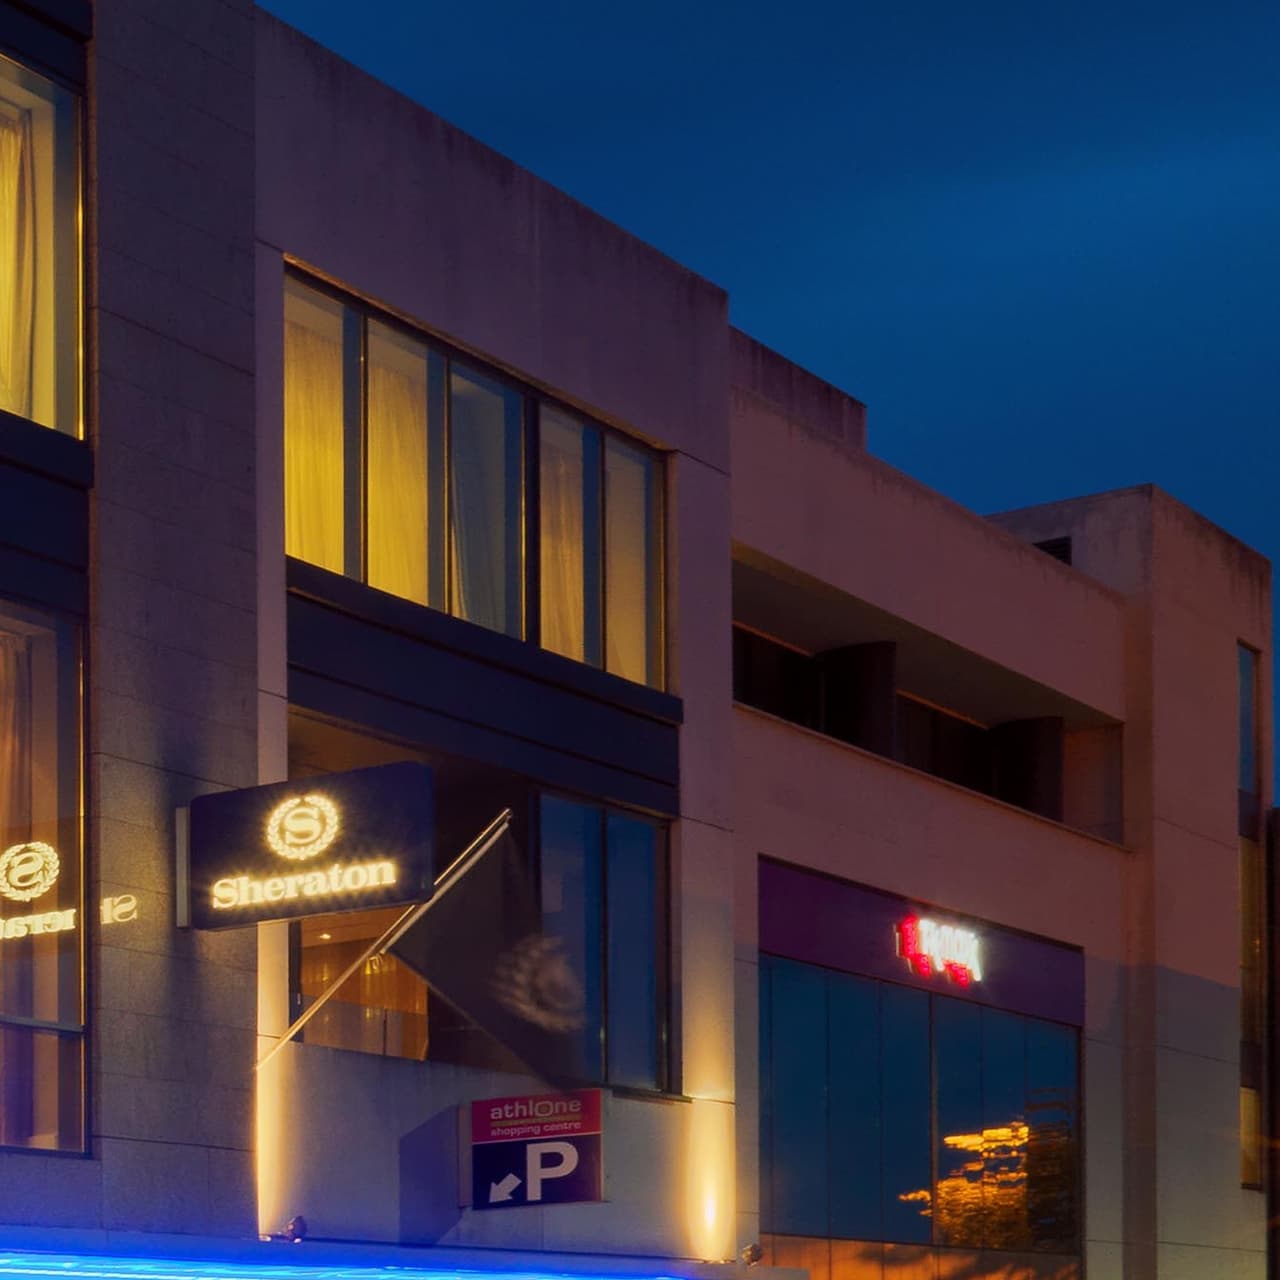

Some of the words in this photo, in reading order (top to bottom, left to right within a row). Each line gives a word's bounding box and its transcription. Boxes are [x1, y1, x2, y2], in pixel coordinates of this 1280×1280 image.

[211, 860, 397, 910] Sheraton
[490, 1126, 541, 1137] shopping
[543, 1121, 582, 1132] centre
[526, 1141, 579, 1201] P
